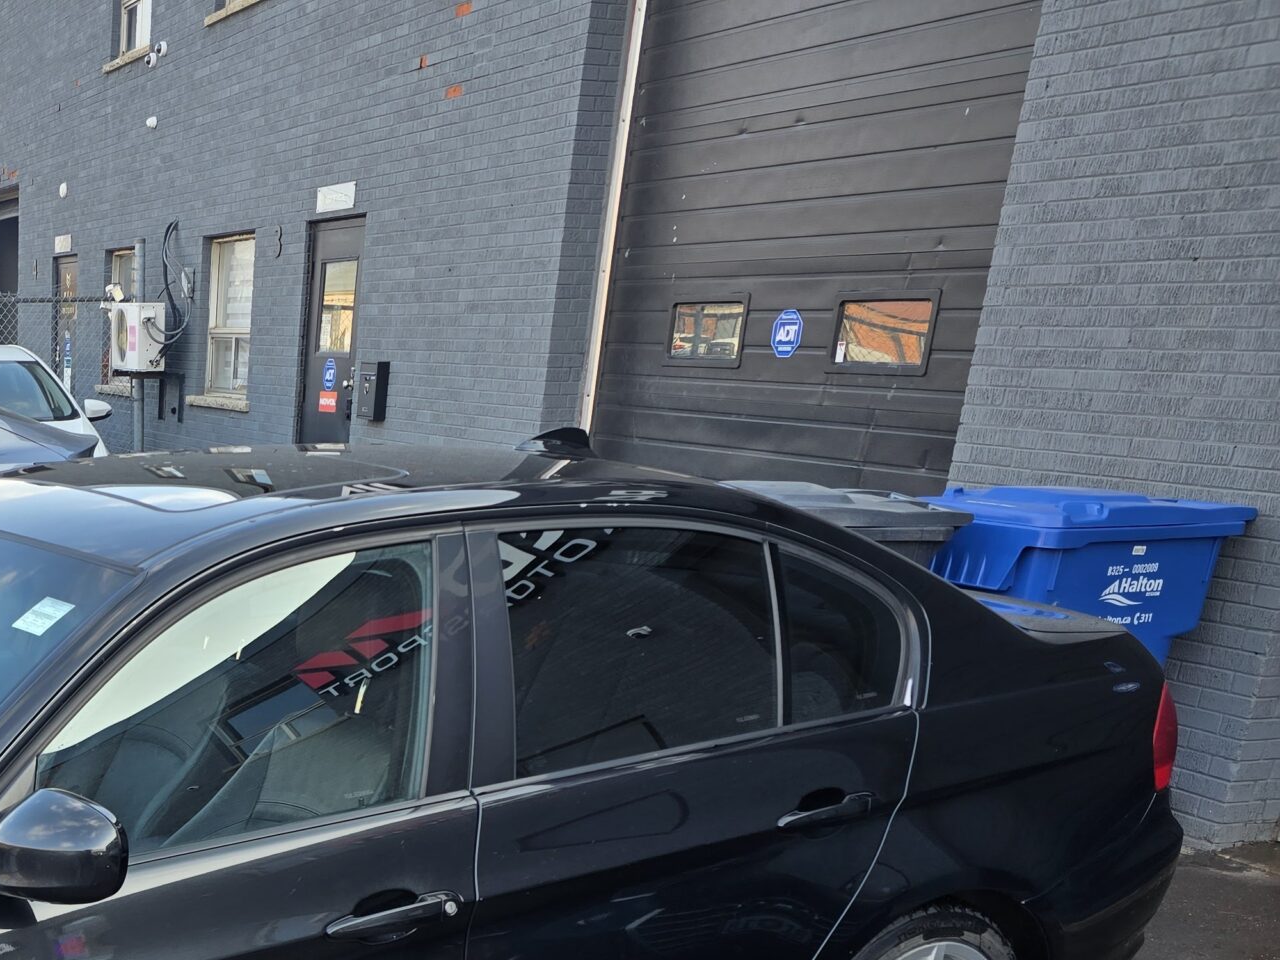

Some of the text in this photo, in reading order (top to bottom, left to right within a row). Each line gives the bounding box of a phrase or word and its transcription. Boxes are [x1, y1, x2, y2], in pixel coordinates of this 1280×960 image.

[775, 325, 799, 342] ADT
[1120, 575, 1164, 593] Halton
[1139, 612, 1153, 623] 311
